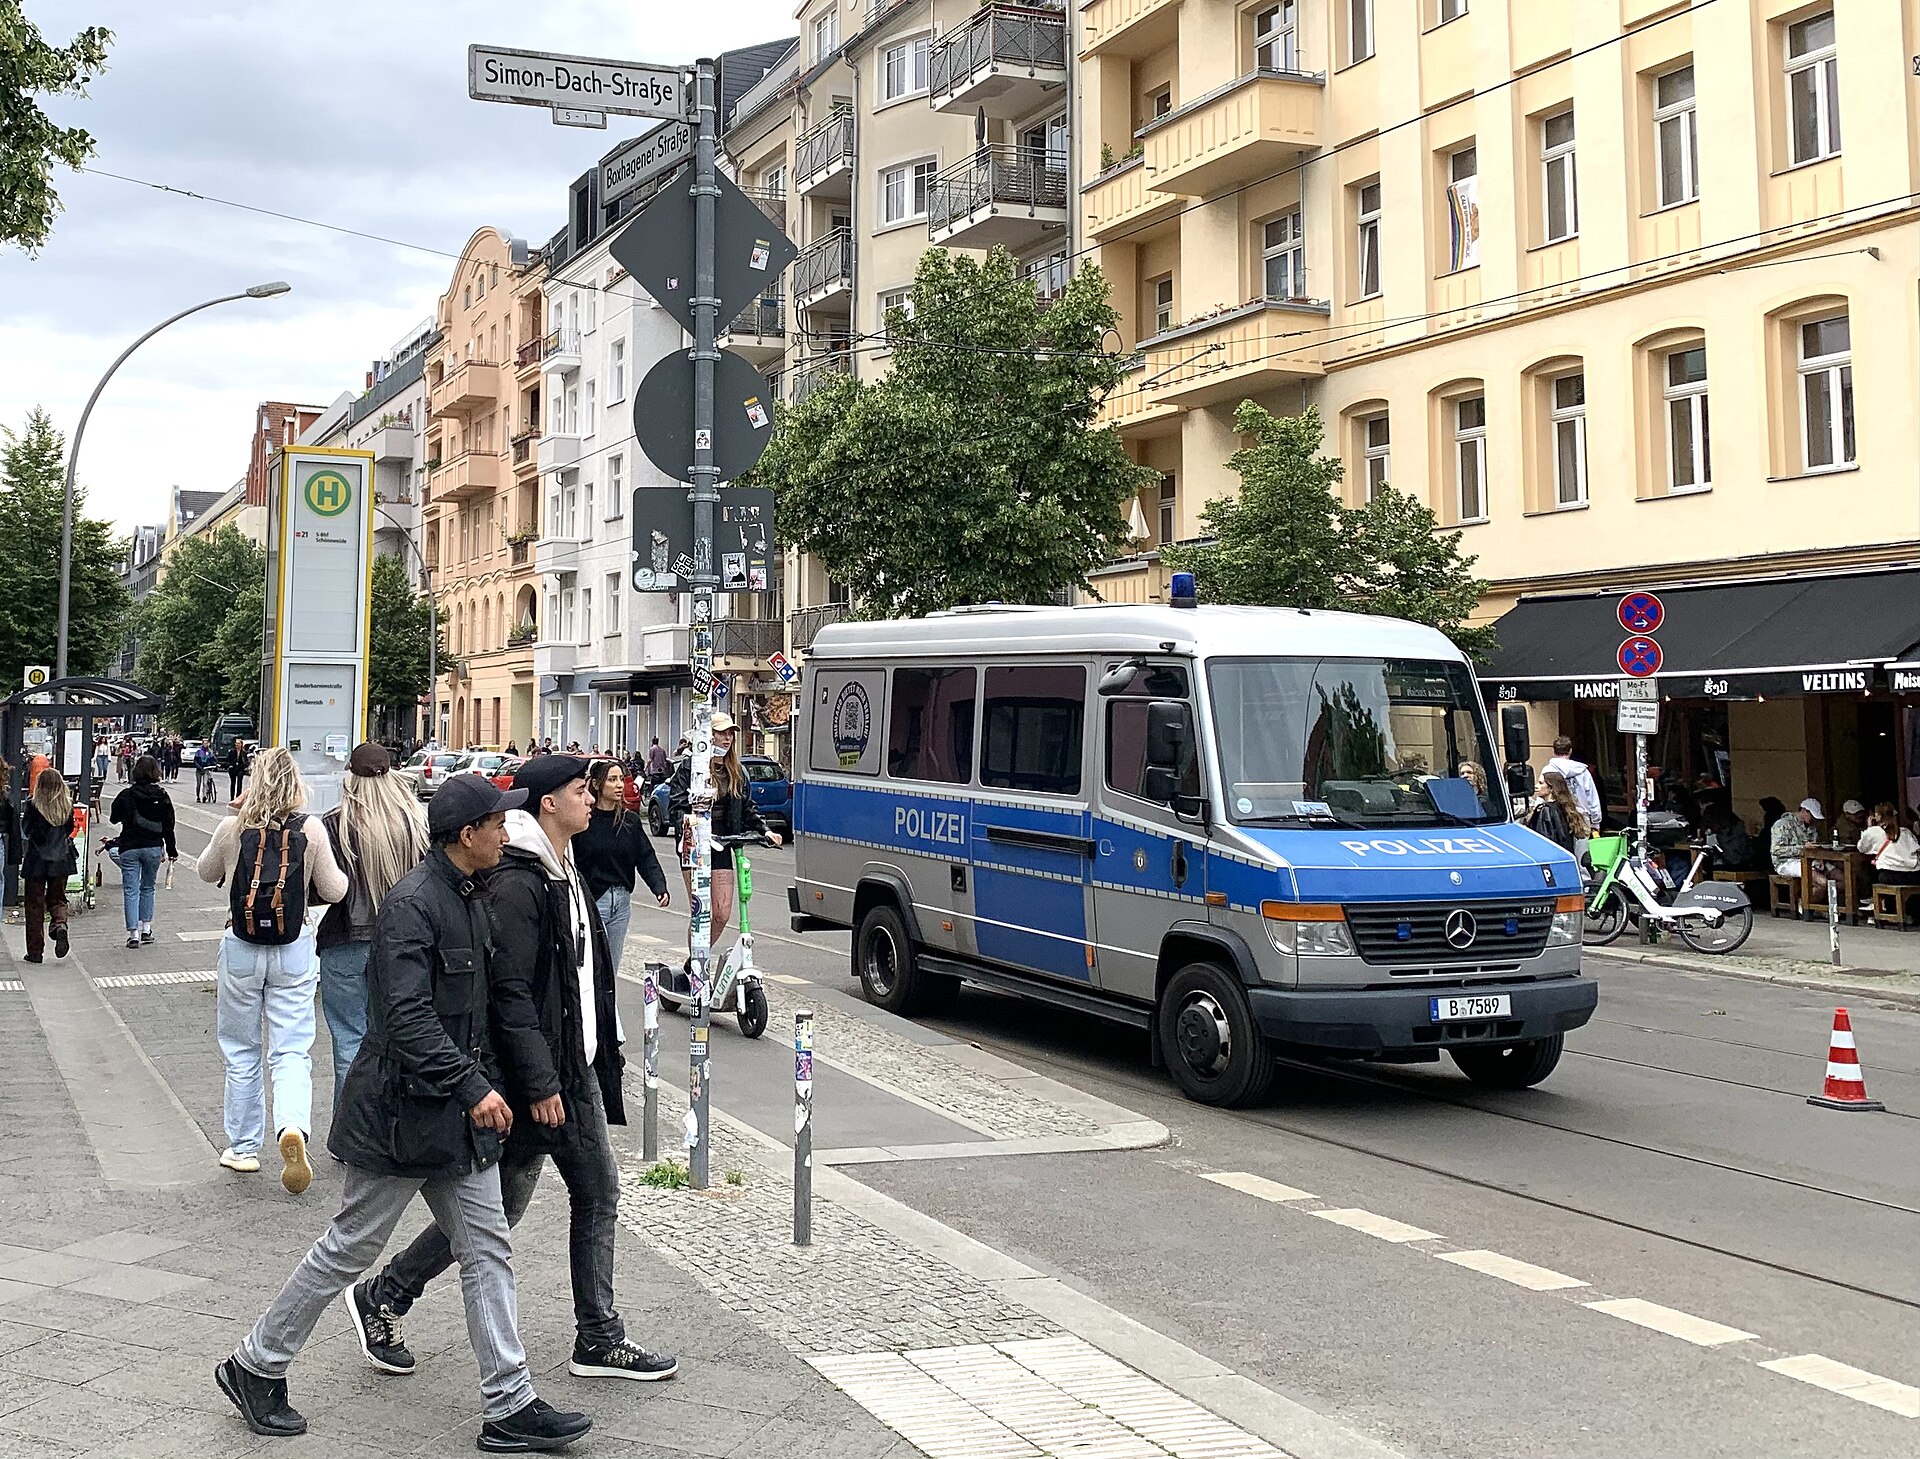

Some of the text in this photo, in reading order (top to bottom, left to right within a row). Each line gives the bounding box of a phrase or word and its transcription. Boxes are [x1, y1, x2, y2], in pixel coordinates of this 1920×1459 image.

[485, 58, 673, 106] Simon-Dach-Straße
[606, 125, 689, 190] Boxhagener Straße
[317, 481, 339, 506] H
[33, 672, 41, 682] H
[1802, 671, 1866, 691] VELTINS
[1574, 682, 1620, 698] HANGM
[895, 806, 965, 845] POLIZEI
[1339, 838, 1505, 857] POLIZEI
[1543, 868, 1552, 882] P
[716, 964, 734, 996] Lime
[1449, 997, 1500, 1017] B 7589
